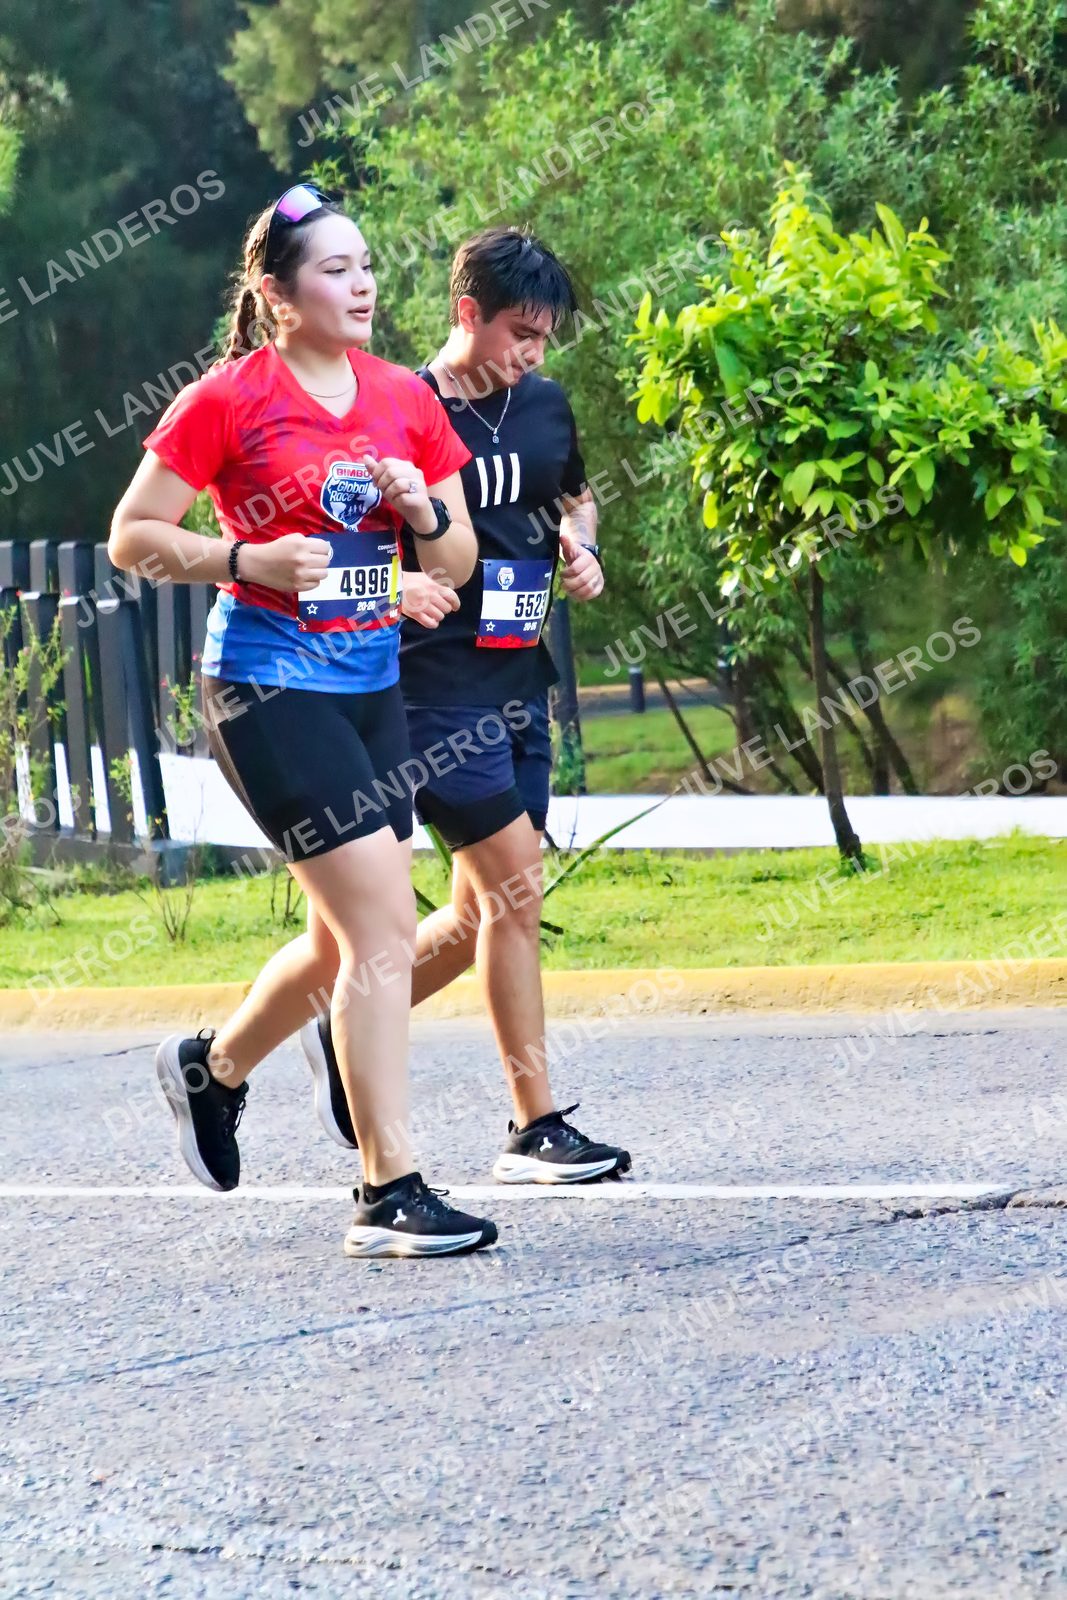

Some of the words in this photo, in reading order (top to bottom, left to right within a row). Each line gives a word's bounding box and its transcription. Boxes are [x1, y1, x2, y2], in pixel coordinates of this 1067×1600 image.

[337, 481, 369, 495] Global
[329, 491, 355, 502] Race
[340, 566, 389, 597] 4996
